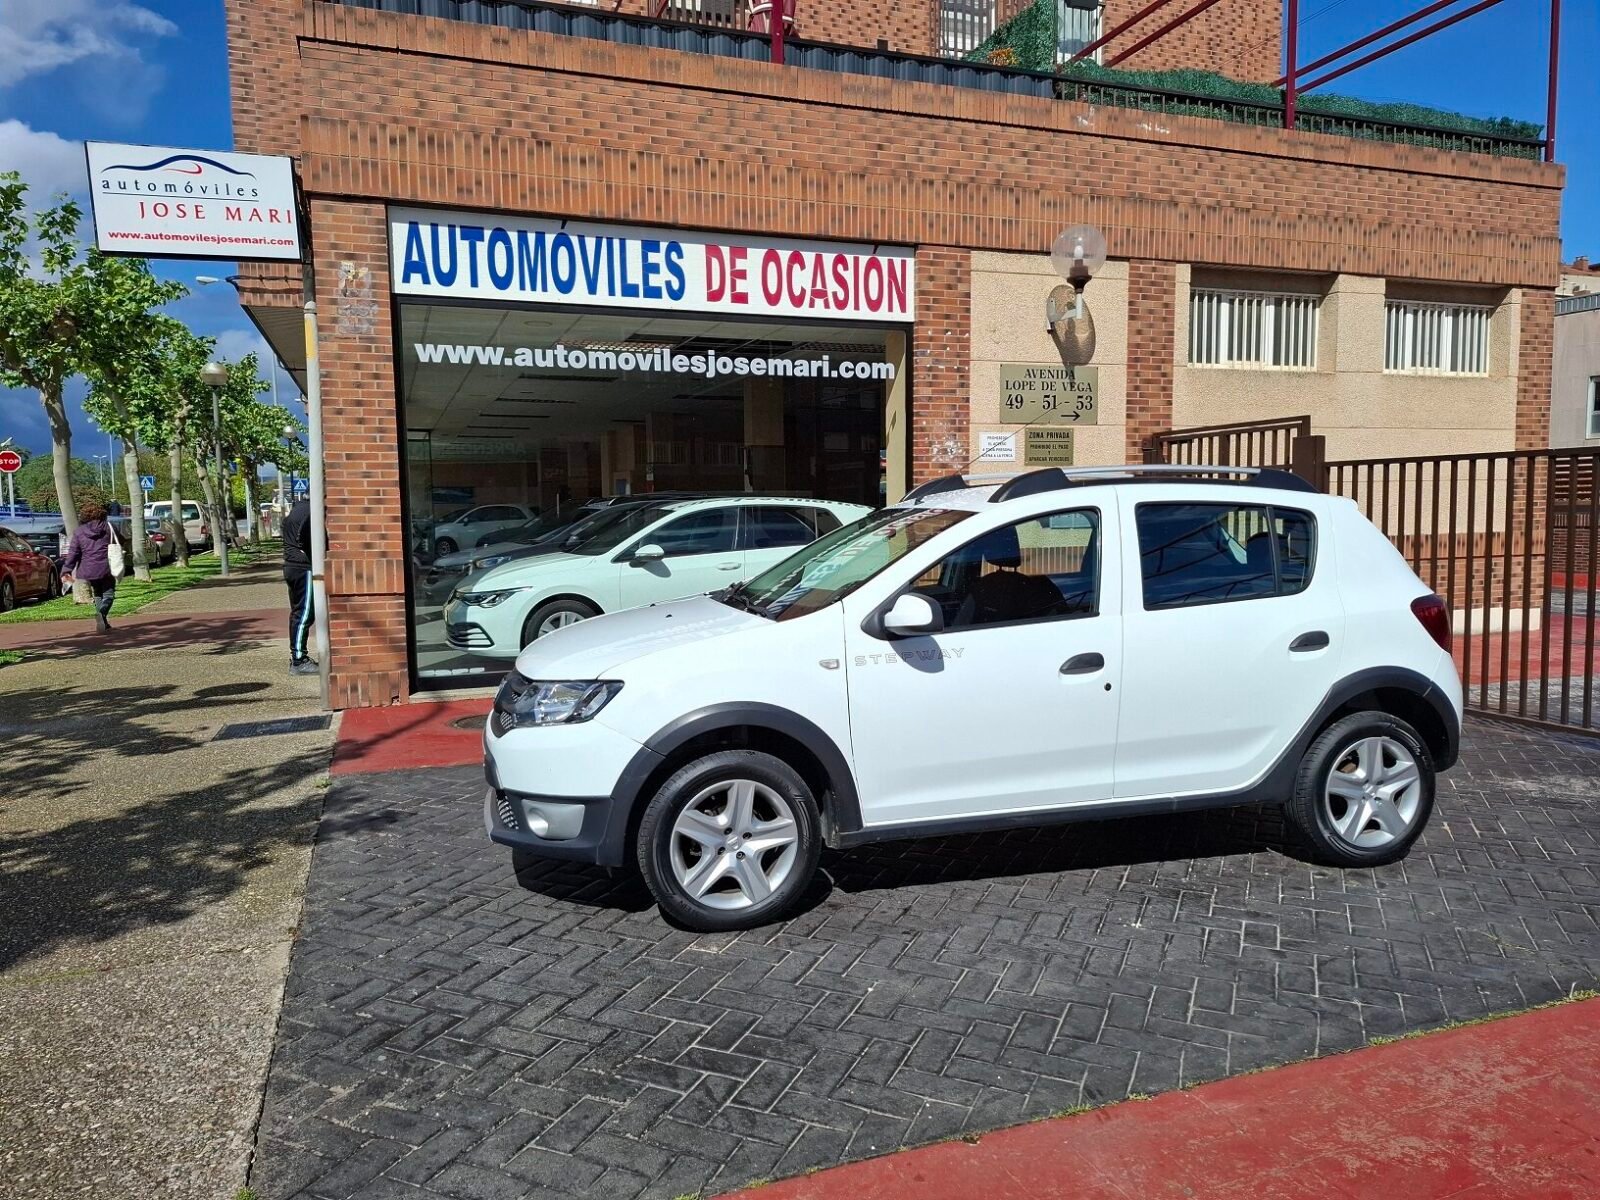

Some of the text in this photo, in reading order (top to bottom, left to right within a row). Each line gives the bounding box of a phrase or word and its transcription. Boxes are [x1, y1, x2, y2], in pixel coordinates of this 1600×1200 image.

[102, 179, 259, 197] automóviles
[139, 202, 292, 224] JOSE MARI
[108, 230, 295, 247] www.automovilesjosemari.com
[402, 219, 686, 302] AUTOMÓVILES
[704, 243, 749, 305] DE
[414, 342, 895, 380] www.automovilesjosemari.com
[1024, 368, 1076, 380] AVENIDA
[1005, 380, 1093, 392] LOPE DE VEGA
[1005, 394, 1024, 410] 49
[1042, 394, 1058, 410] 51
[1076, 395, 1093, 411] 53
[1028, 431, 1070, 439] ZONA PRIVADA
[854, 647, 965, 667] STEPWAY
